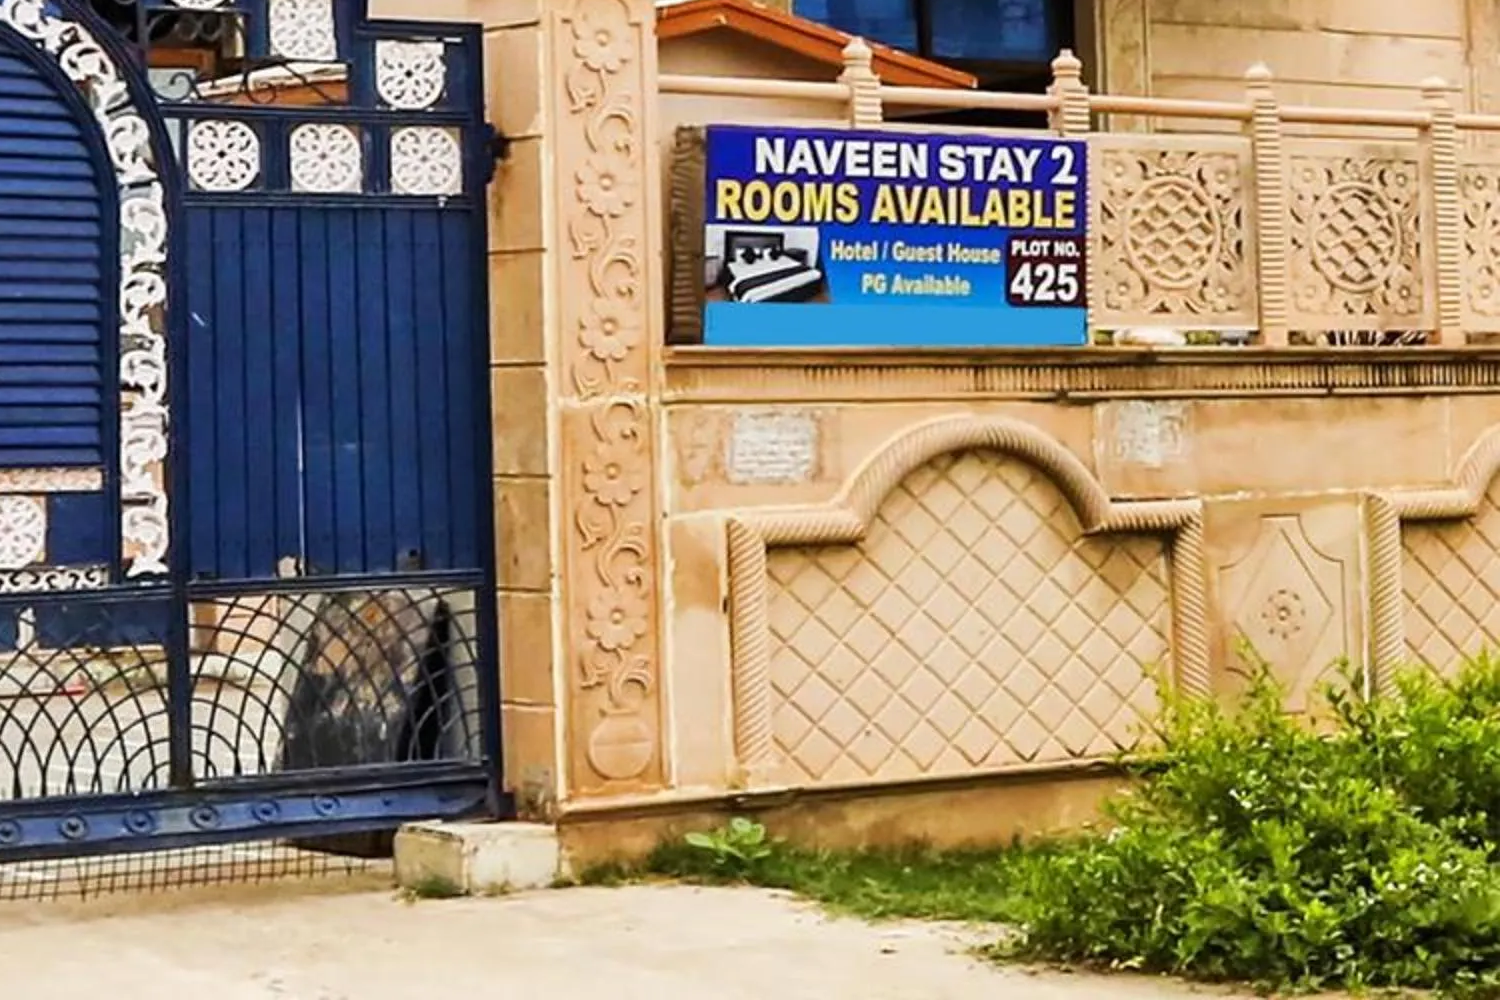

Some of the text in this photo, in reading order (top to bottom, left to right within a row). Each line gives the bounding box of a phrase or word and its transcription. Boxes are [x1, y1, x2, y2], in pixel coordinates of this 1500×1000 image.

[755, 137, 1078, 185] NAVEEN STAY 2
[715, 179, 1076, 229] ROOMS AVAILABLE
[831, 240, 878, 261] Hotel
[892, 241, 943, 263] Guest
[947, 243, 1000, 264] House
[1010, 239, 1081, 258] PLOT NO.
[860, 273, 971, 297] PG Available
[1009, 263, 1079, 301] 425
